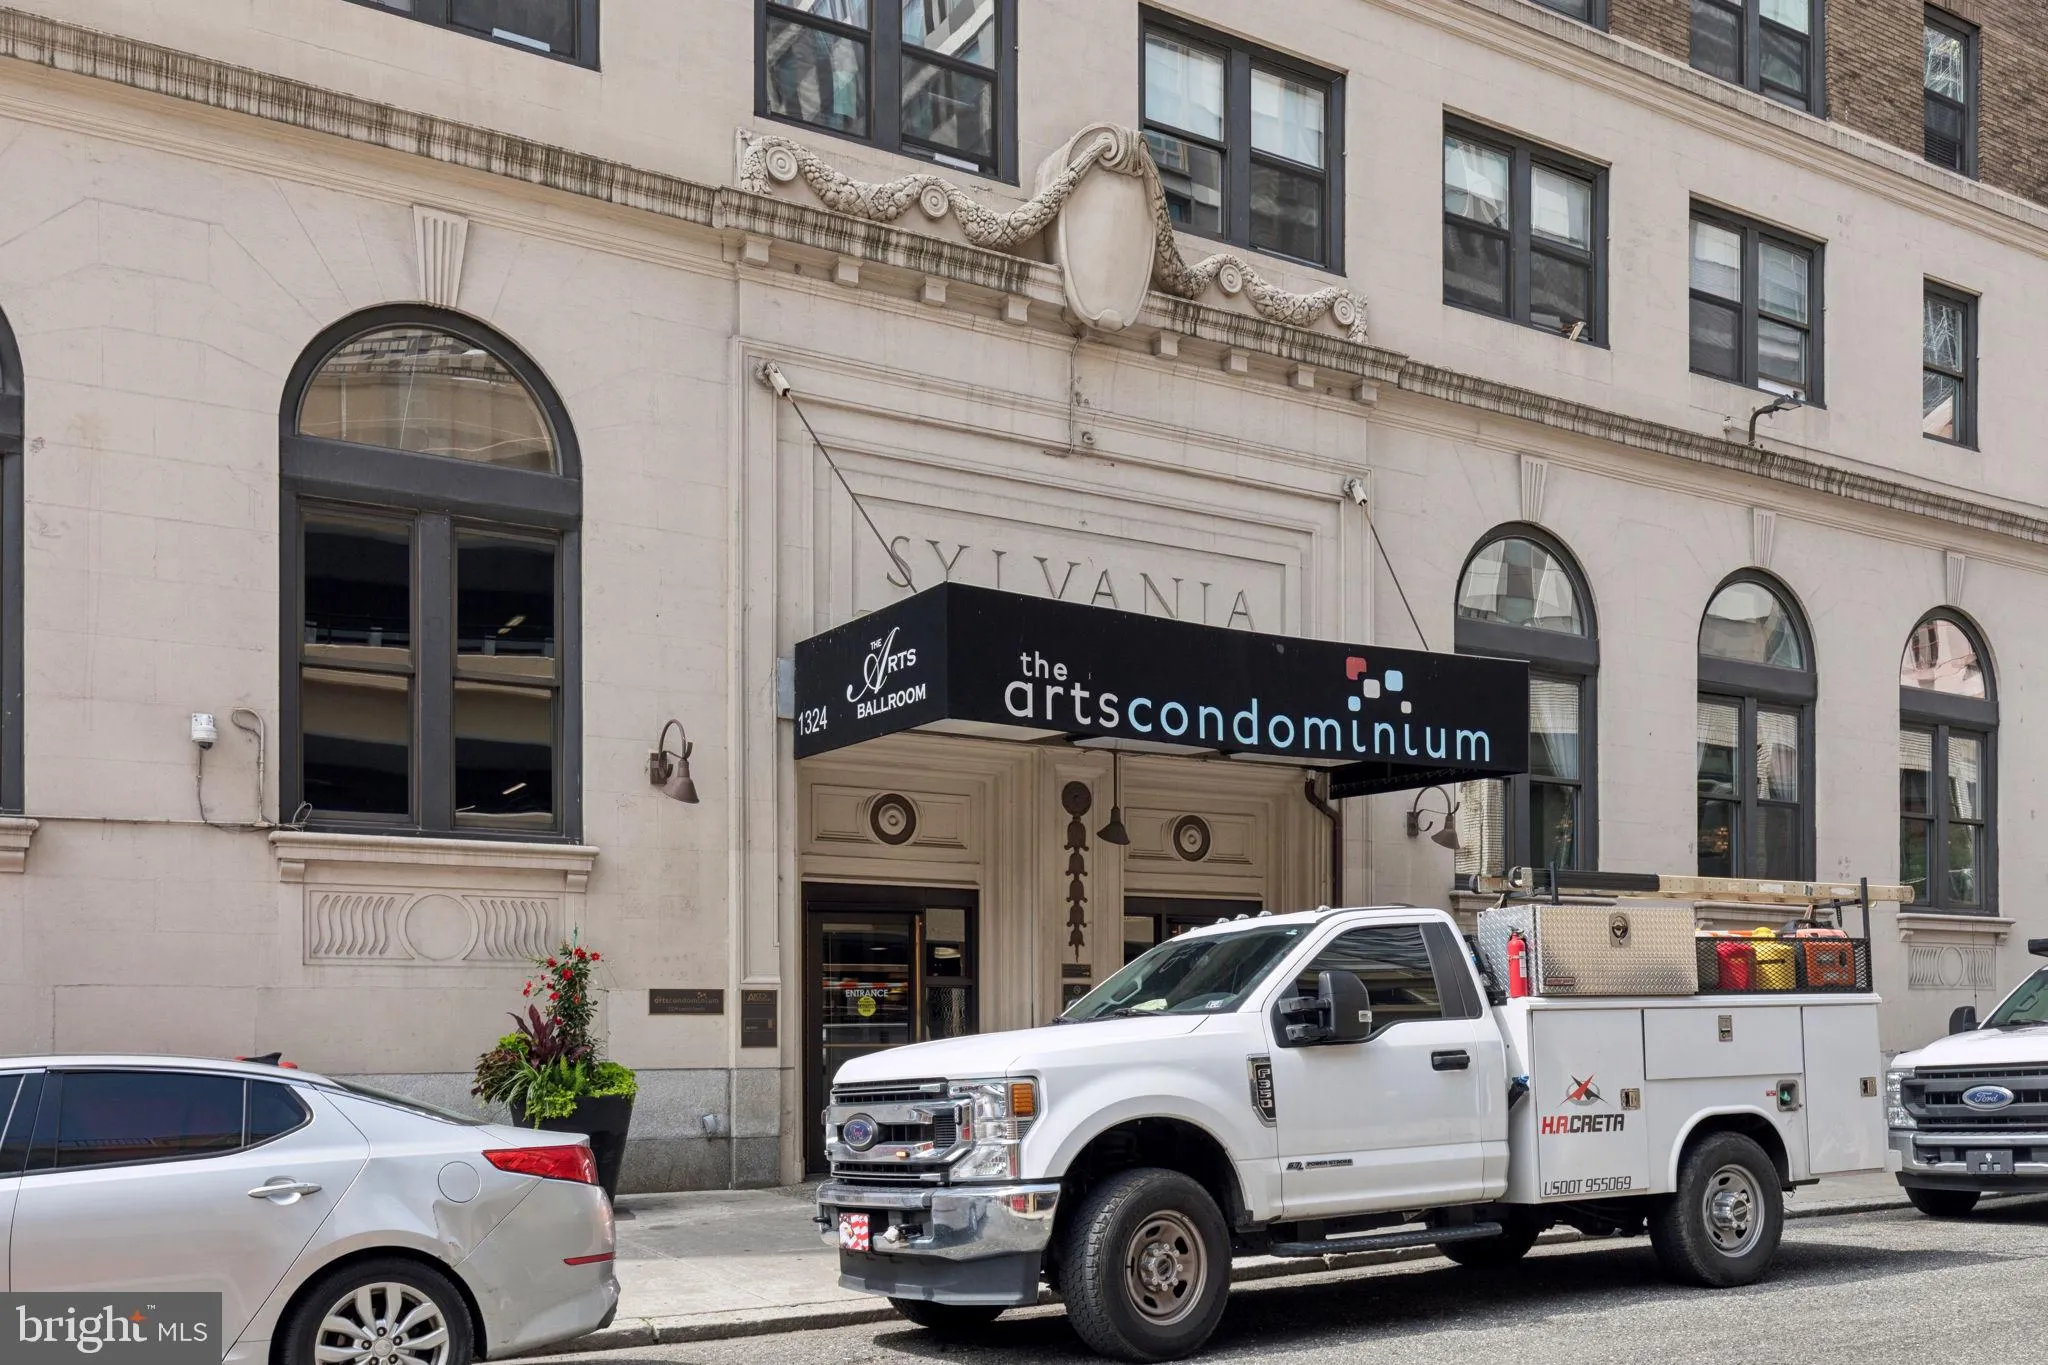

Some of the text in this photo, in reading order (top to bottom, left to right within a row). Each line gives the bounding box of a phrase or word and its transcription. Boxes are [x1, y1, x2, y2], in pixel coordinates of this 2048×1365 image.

[870, 638, 882, 650] THE
[1020, 651, 1068, 681] the
[857, 683, 926, 719] BALLROOM
[799, 706, 827, 735] 1324
[845, 989, 889, 998] ENTRANCE
[1257, 1068, 1273, 1108] F350
[1974, 1092, 1999, 1103] Ford
[1544, 1175, 1632, 1196] USDOT 955069
